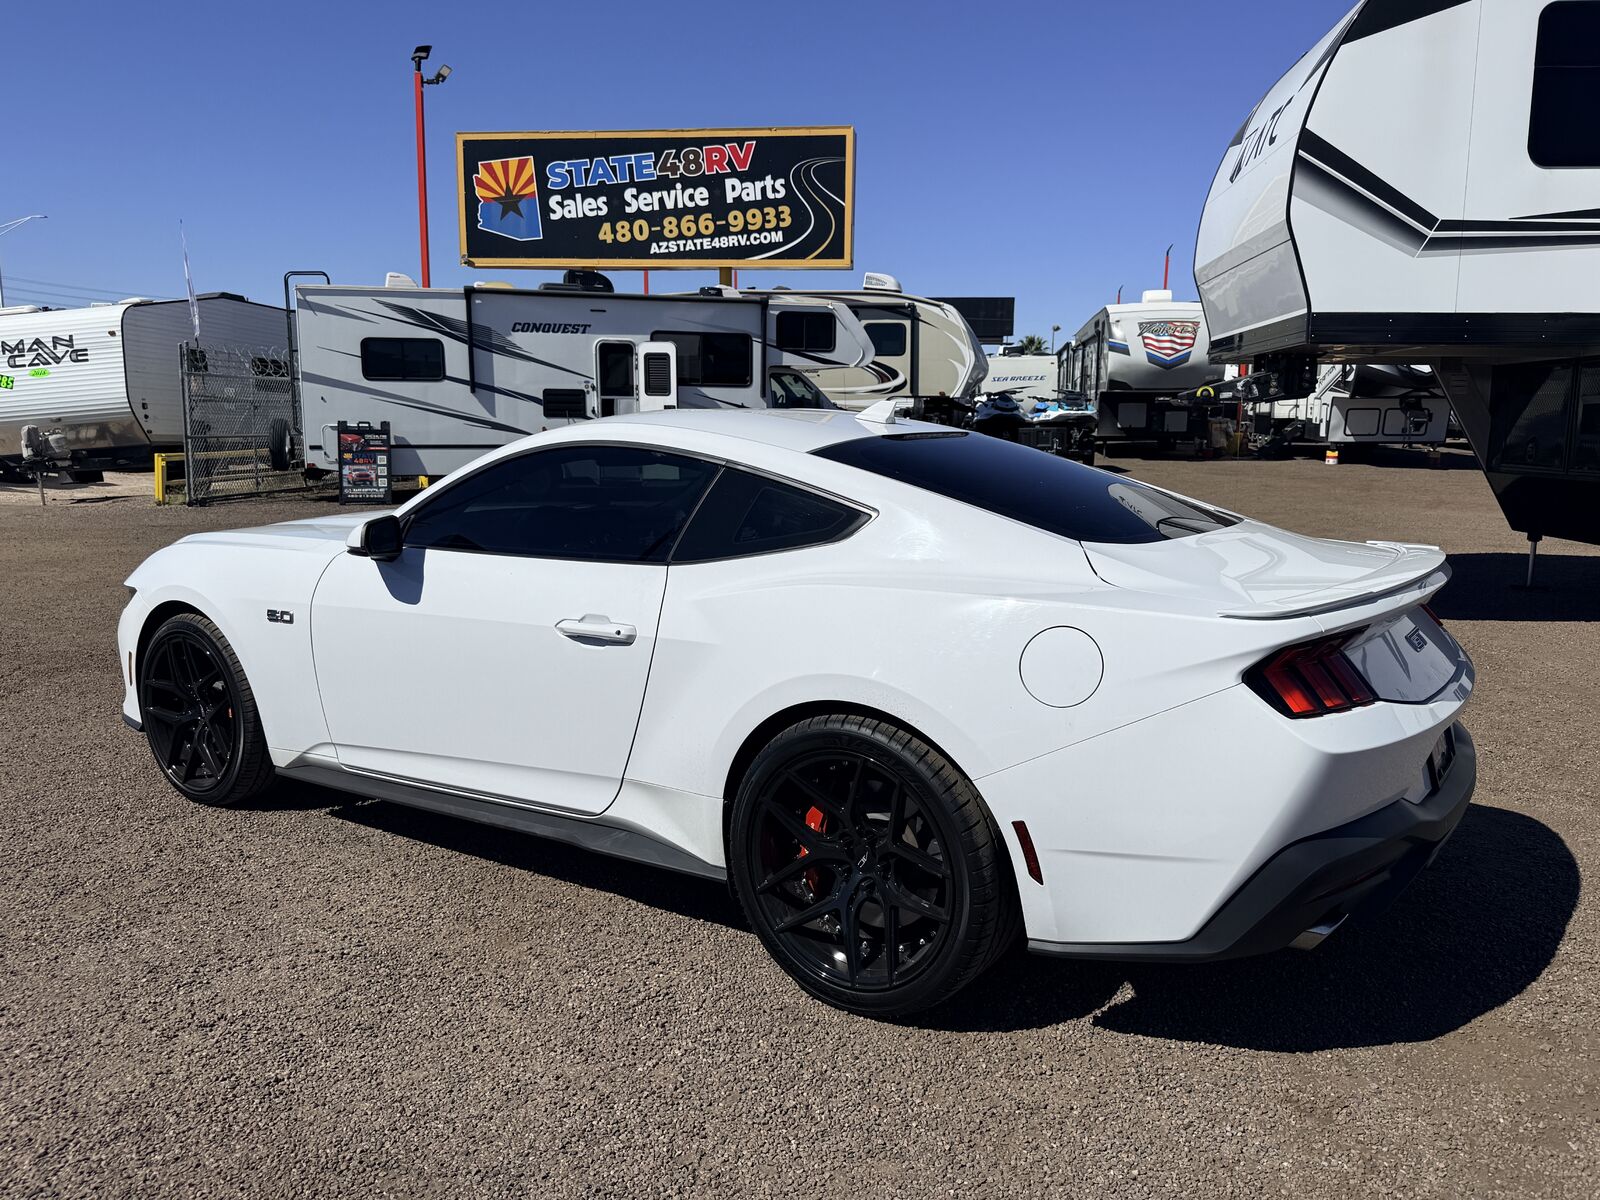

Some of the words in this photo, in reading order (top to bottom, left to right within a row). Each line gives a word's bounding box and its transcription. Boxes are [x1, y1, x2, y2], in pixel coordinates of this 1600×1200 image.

[548, 193, 609, 220] Sales
[623, 182, 710, 214] Service
[724, 174, 786, 204] Parts
[598, 205, 793, 244] 480-866-9933
[649, 230, 784, 255] AZSTATE48RV.COM
[511, 321, 592, 335] CONQUEST
[1, 334, 75, 356] MAN
[7, 348, 89, 368] CAVE
[0, 375, 14, 389] 85
